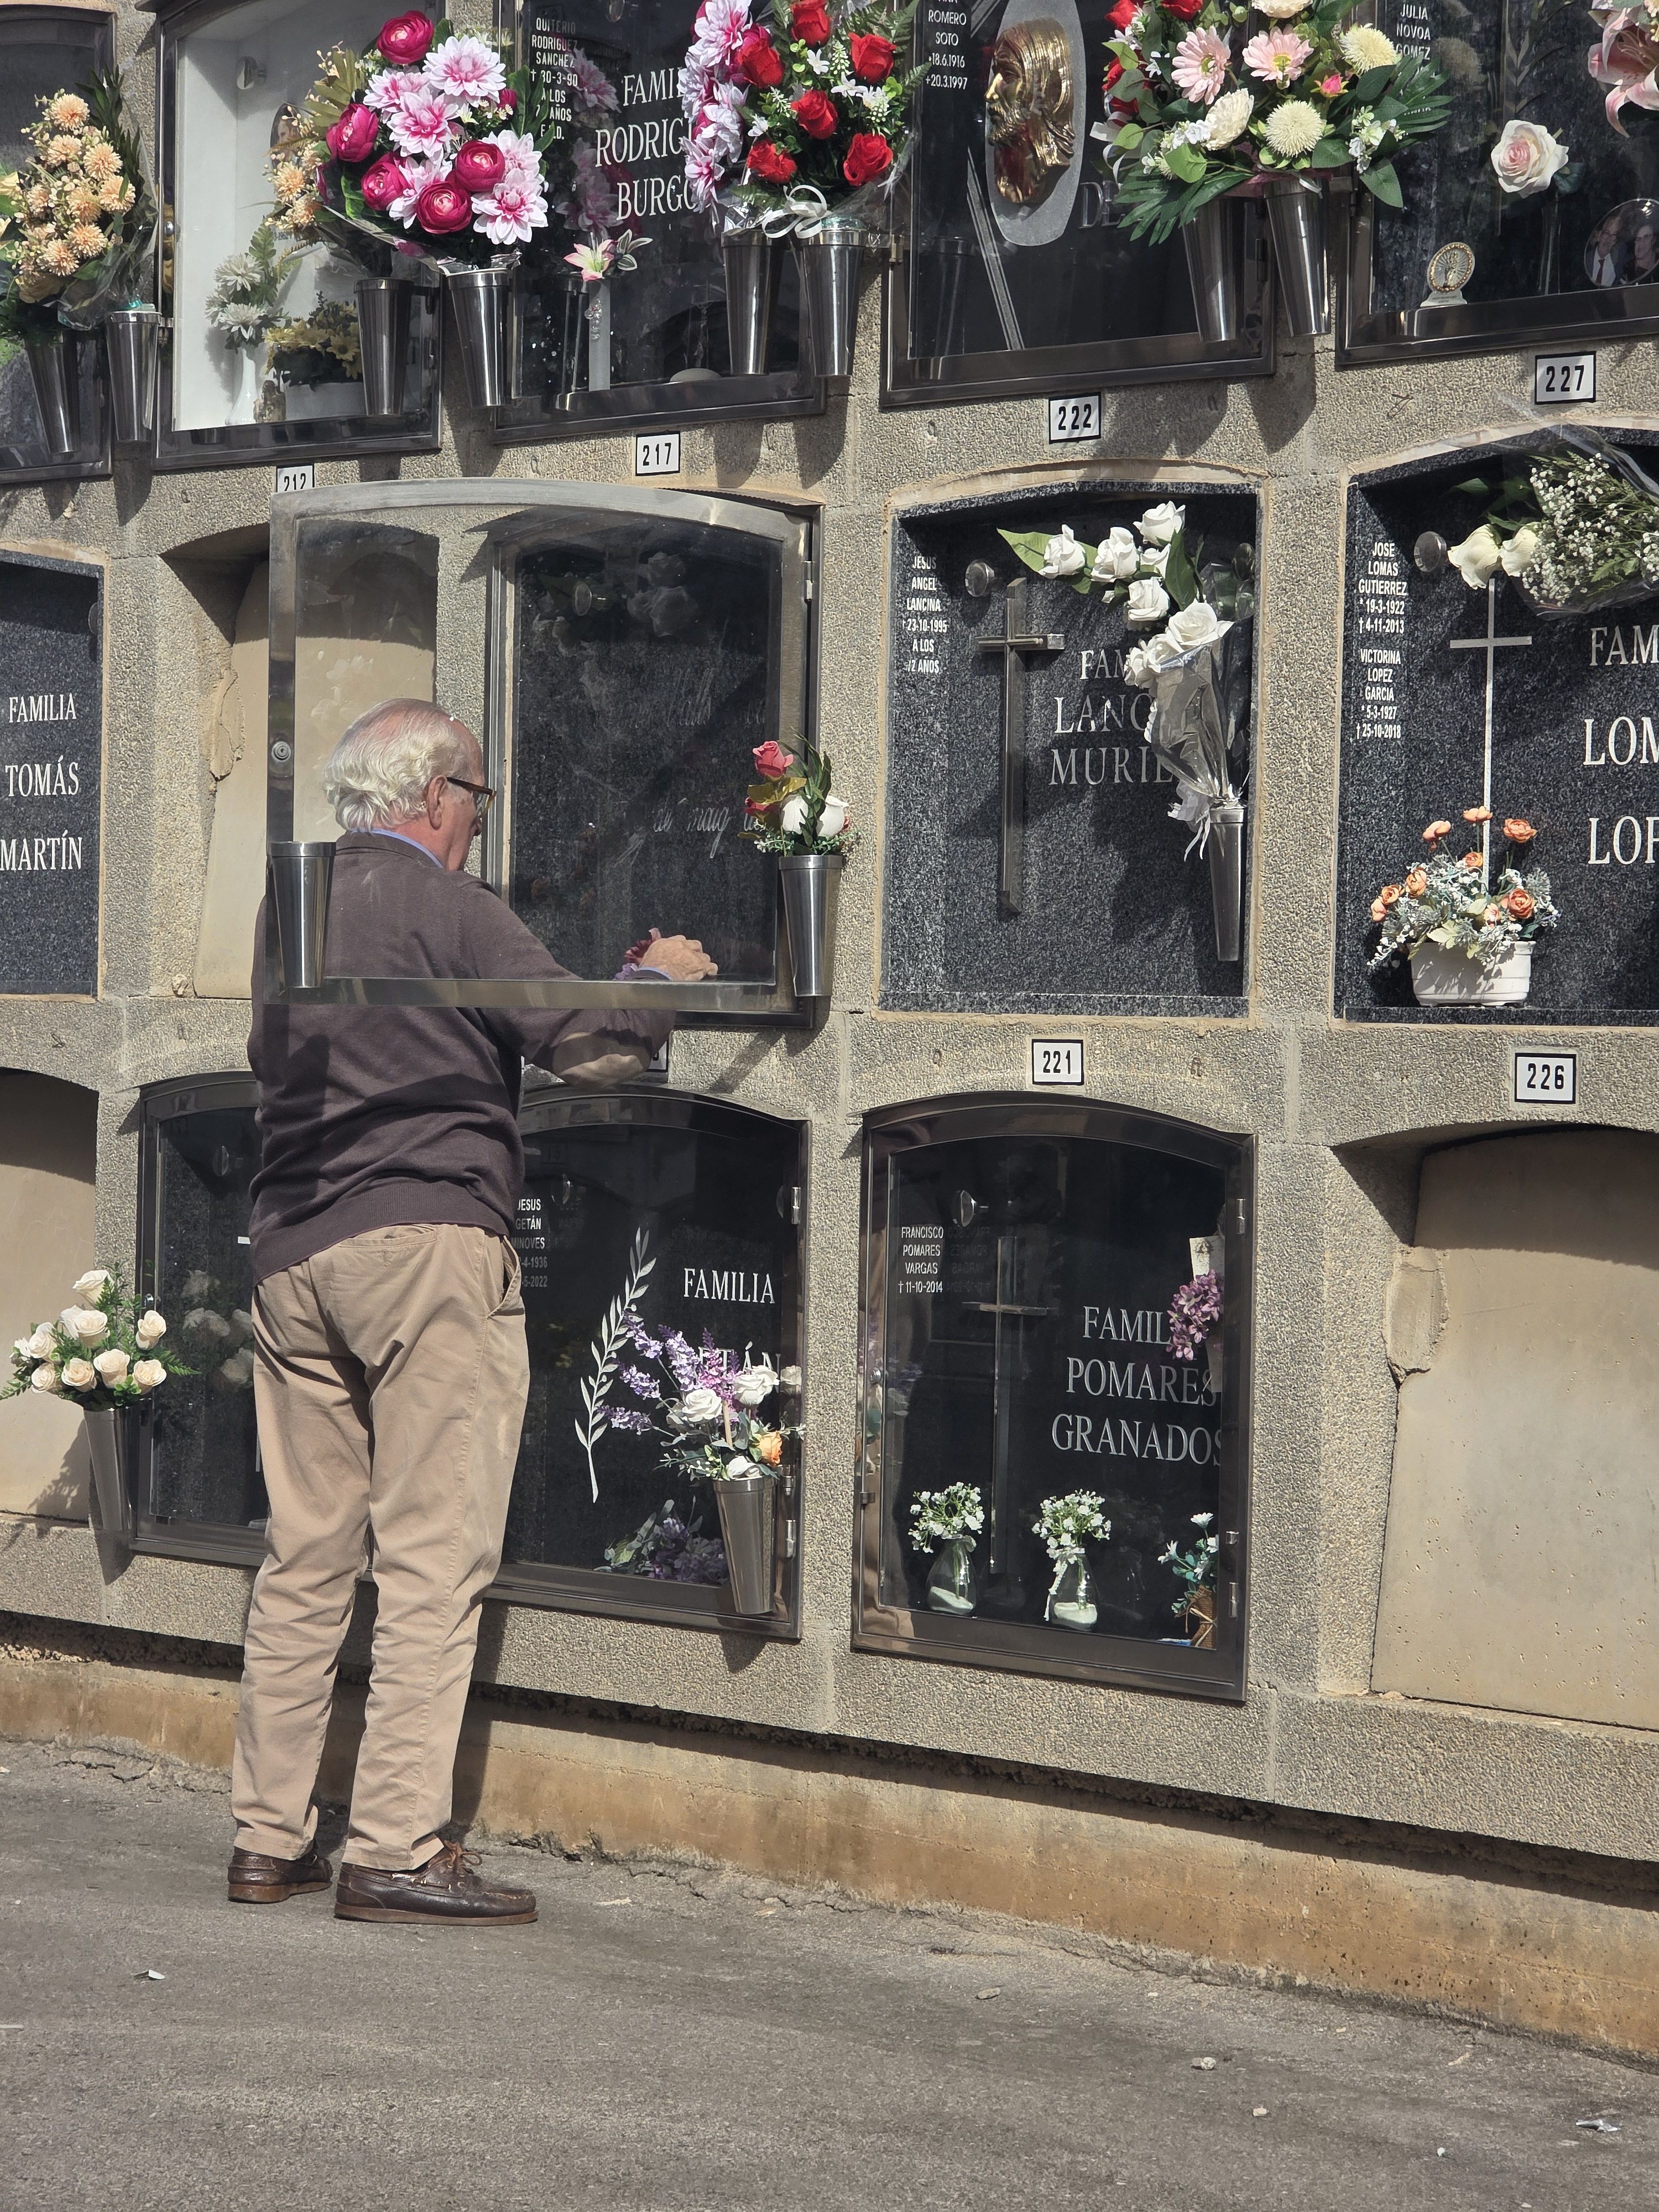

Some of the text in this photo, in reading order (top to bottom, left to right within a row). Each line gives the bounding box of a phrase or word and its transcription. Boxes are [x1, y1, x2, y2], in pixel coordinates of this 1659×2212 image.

[928, 9, 967, 25] ROMERO
[1400, 3, 1428, 20] JULIA
[536, 17, 576, 34] QUITERIO
[1396, 23, 1431, 40] NOVOA
[531, 34, 577, 53] RODRIGUEZ
[936, 32, 959, 46] SOTO
[536, 51, 575, 68] SANCHEZ
[1396, 43, 1431, 60] GOMEZ
[549, 88, 566, 103] LOS
[549, 103, 572, 122] AÑOS
[595, 117, 692, 167] RODRIG
[1546, 365, 1584, 392] 227
[1058, 404, 1092, 430] 222
[643, 442, 671, 466] 217
[284, 473, 306, 491] 212
[1372, 541, 1395, 557] JOSE
[912, 556, 937, 570] JESUS
[1368, 560, 1399, 576] LOMAS
[911, 577, 937, 591] ANGEL
[1358, 579, 1407, 596] GUTIERREZ
[906, 598, 941, 612] LANCINA
[912, 638, 935, 653] A LOS
[917, 656, 940, 674] AÑOS
[1360, 648, 1401, 665] VICTORINA
[1368, 667, 1393, 682] LOPEZ
[1365, 686, 1394, 701] GARCIA
[9, 693, 77, 723] FAMILIA
[1048, 747, 1180, 785] MURIL
[5, 755, 80, 796] TOMÁS
[0, 830, 82, 871] MARTÍN
[1043, 1050, 1071, 1074] 221
[1527, 1063, 1564, 1091] 226
[517, 1198, 541, 1211] JESUS
[515, 1215, 541, 1230] GETÁN
[901, 1226, 944, 1239] FRANCISCO
[902, 1244, 941, 1256] POMARES
[519, 1256, 548, 1268] -4-1936
[905, 1262, 938, 1274] VARGAS
[521, 1275, 548, 1287] -5-2022
[684, 1267, 775, 1303] FAMILIA
[1066, 1357, 1217, 1407] POMARES
